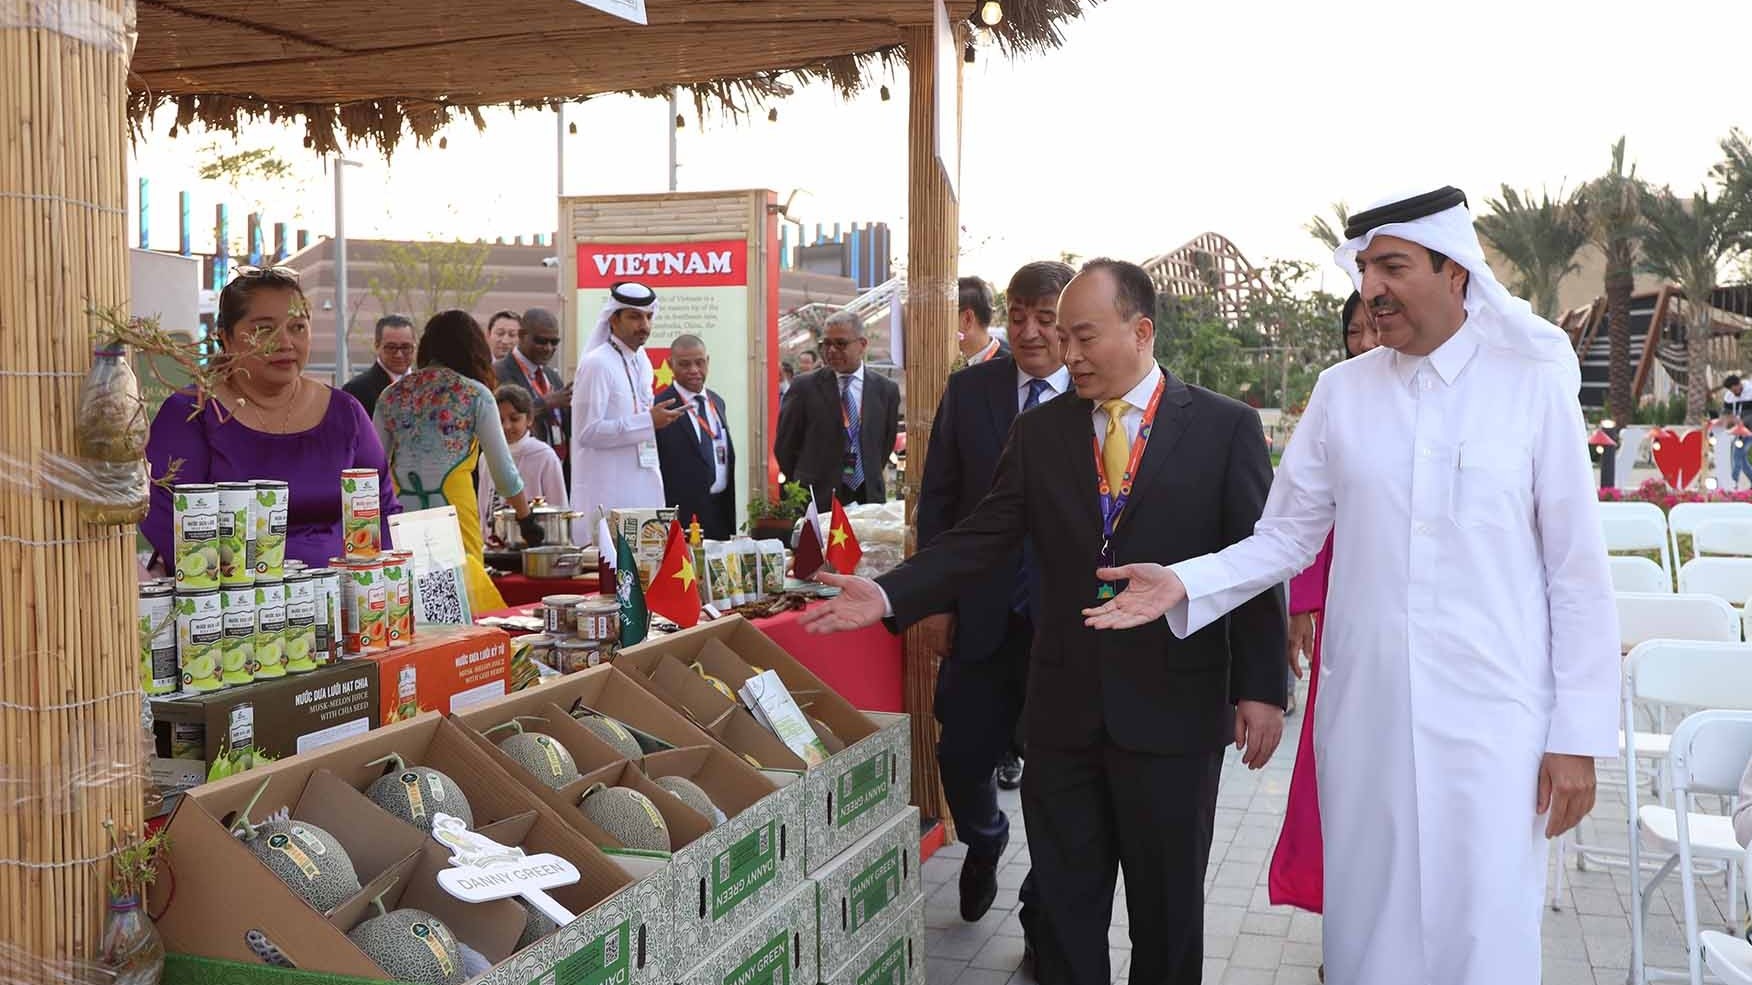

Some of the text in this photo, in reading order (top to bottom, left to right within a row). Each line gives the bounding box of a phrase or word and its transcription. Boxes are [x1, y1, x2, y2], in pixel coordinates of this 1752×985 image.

[593, 251, 731, 276] VIETNAM
[351, 691, 368, 703] JUICE
[354, 676, 368, 690] CHIA
[320, 702, 368, 721] WITH CHIA SEED
[840, 781, 887, 818] DANNY GREEN
[456, 862, 565, 890] DANNY GREEN
[716, 858, 774, 908] DANNY GREEN
[851, 856, 896, 899] DANNY GREEN
[757, 942, 785, 972] GREEN
